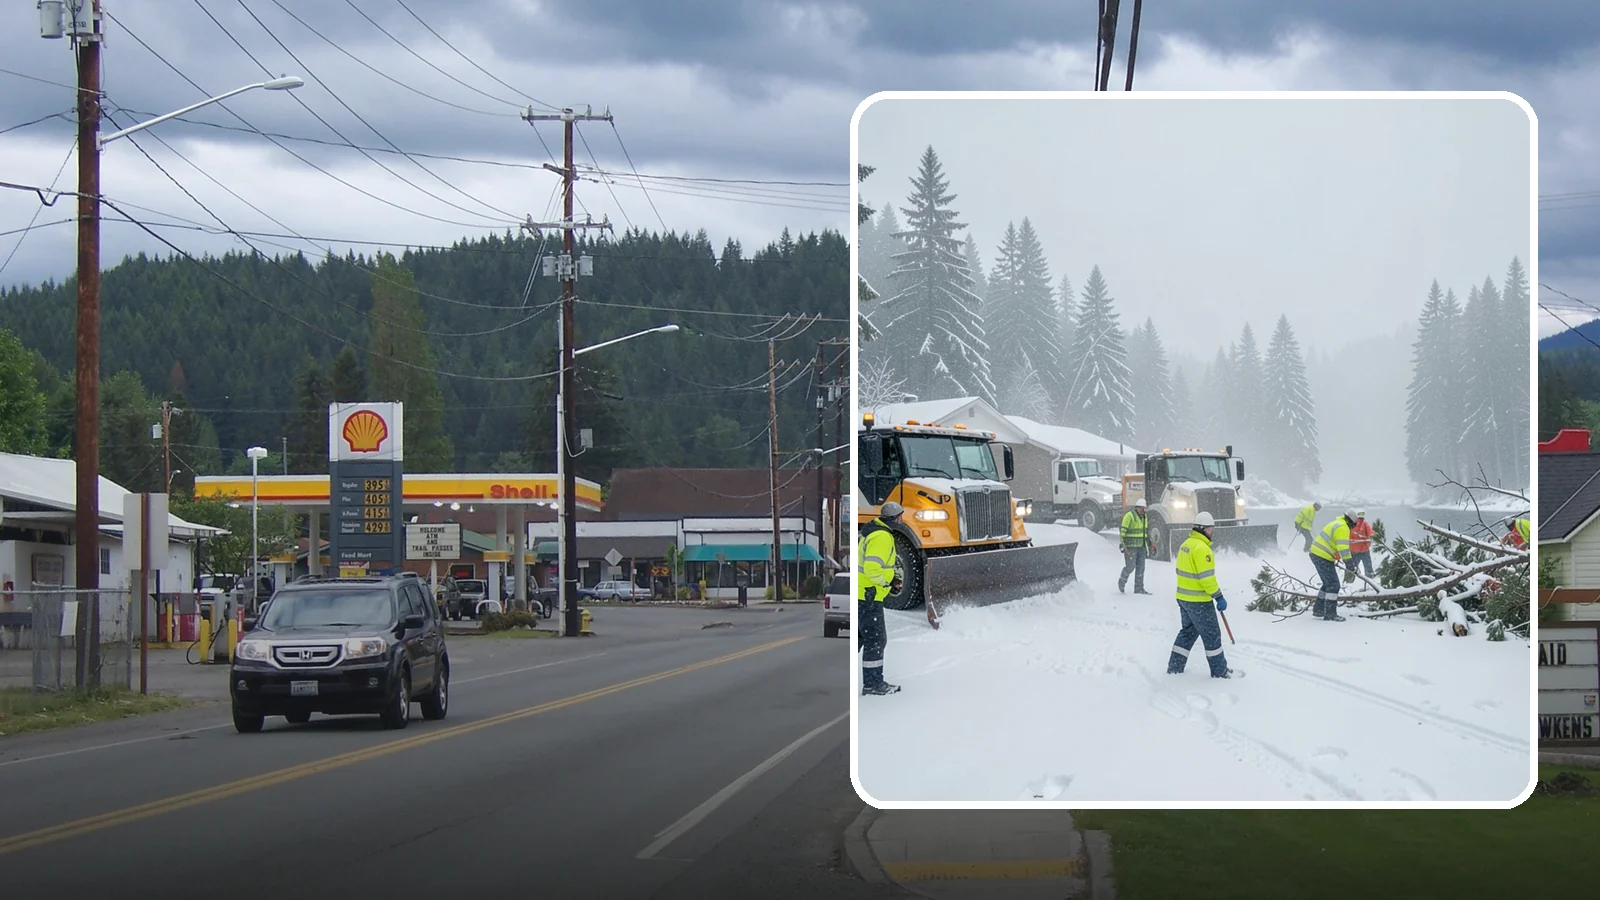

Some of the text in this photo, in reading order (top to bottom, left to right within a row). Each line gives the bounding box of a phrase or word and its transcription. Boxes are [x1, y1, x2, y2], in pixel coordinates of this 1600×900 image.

[365, 480, 383, 490] 395
[490, 484, 547, 499] Shell
[365, 494, 383, 504] 405
[365, 508, 383, 518] 415
[365, 522, 383, 532] 429
